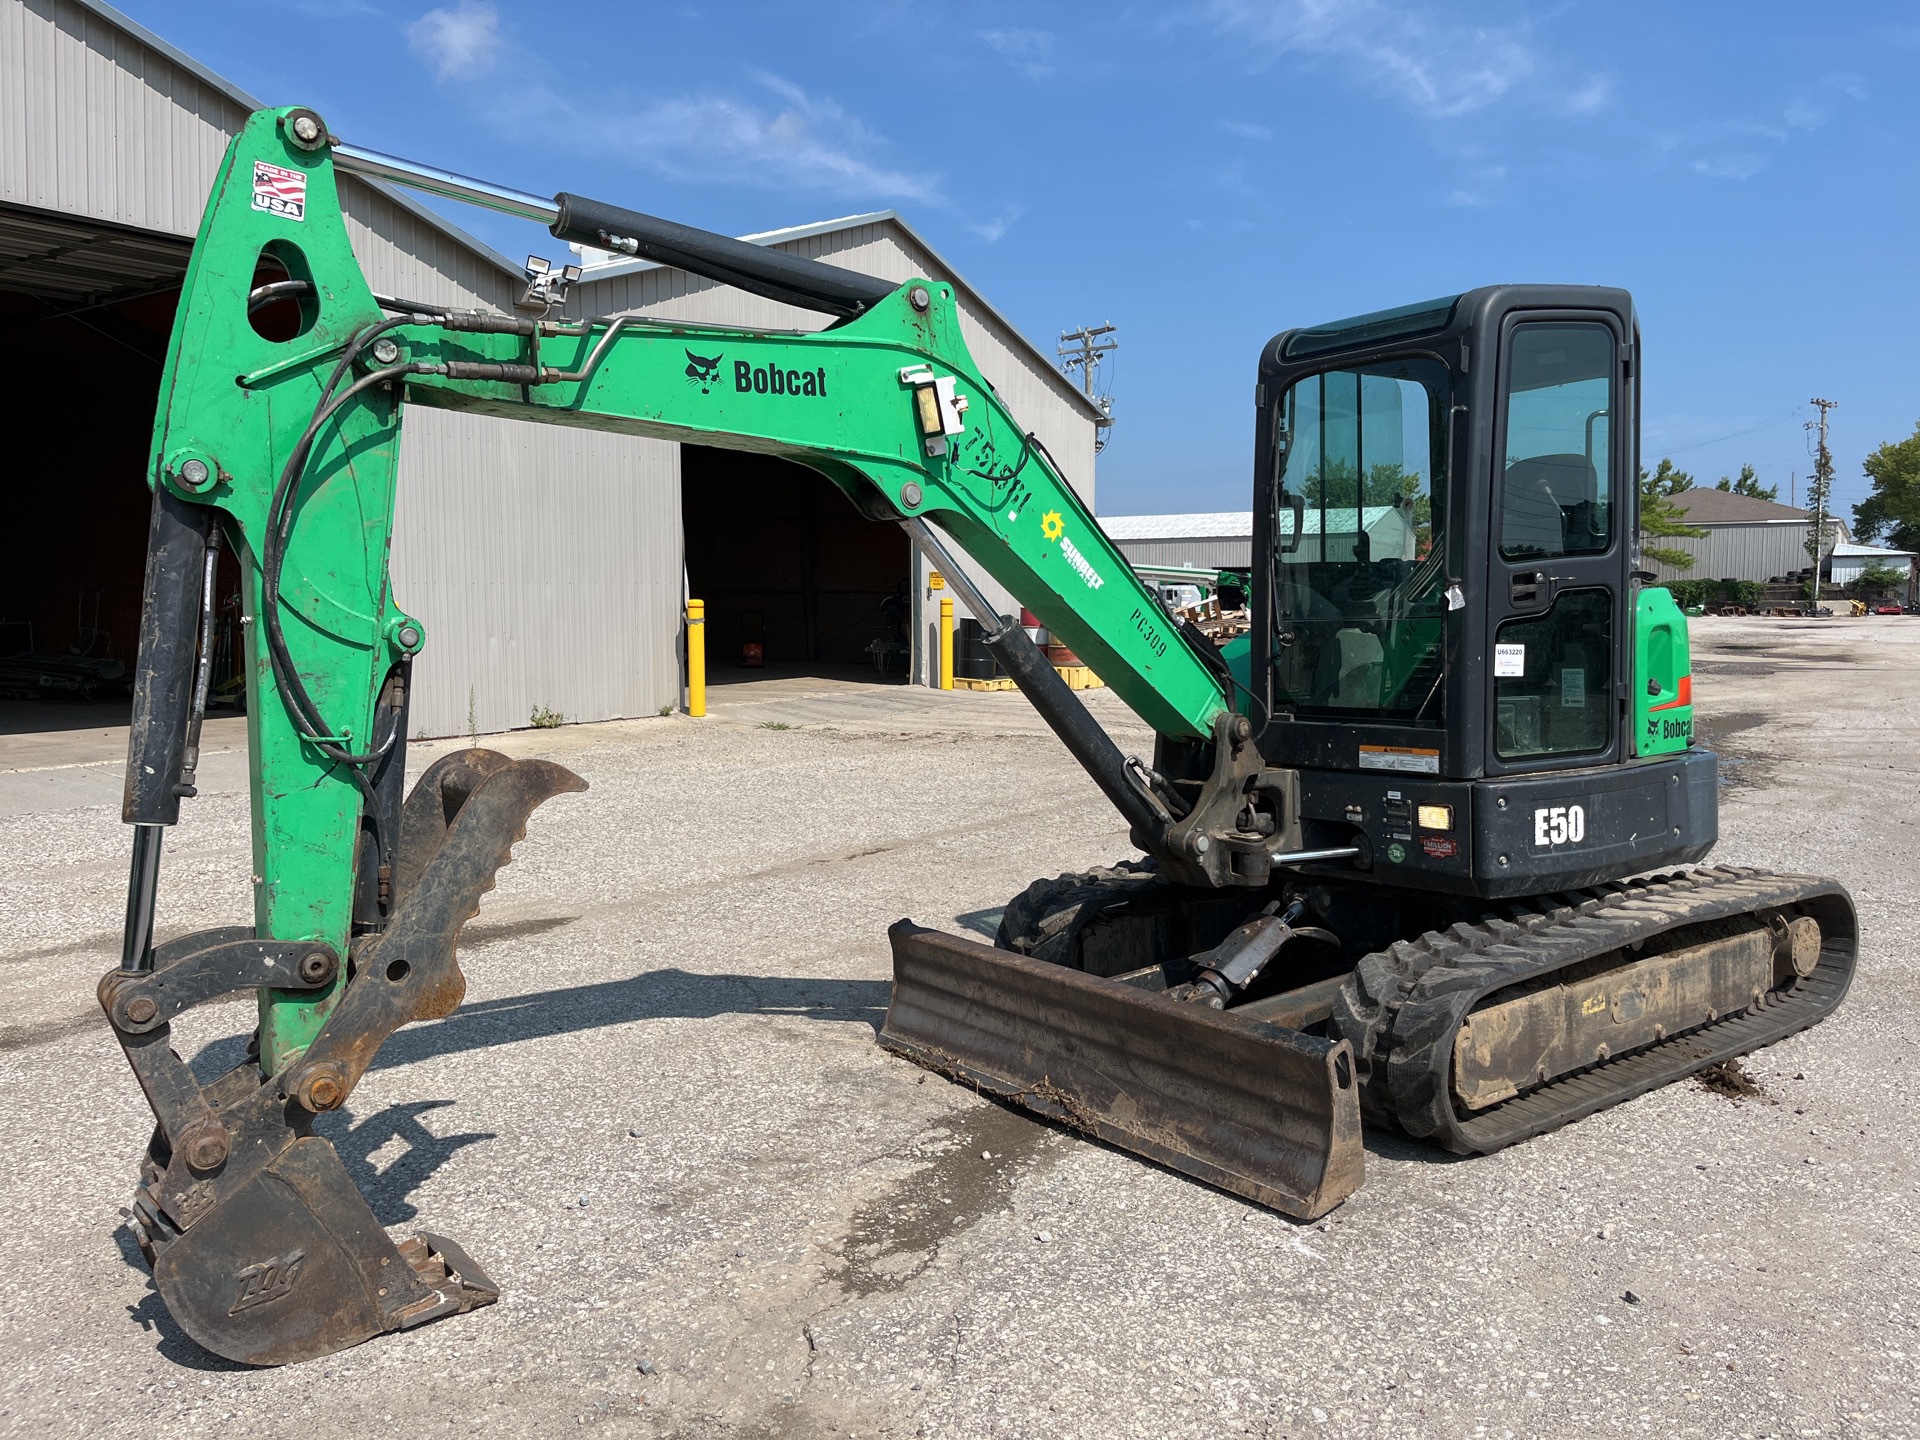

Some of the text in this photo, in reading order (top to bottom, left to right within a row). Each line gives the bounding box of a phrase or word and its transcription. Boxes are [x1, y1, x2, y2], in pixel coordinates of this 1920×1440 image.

[258, 164, 279, 175] MADE
[289, 172, 303, 180] THE
[255, 194, 300, 216] USA
[734, 360, 827, 397] Bobcat
[1059, 536, 1105, 590] SUNBELT
[1129, 608, 1168, 658] PC309
[1534, 804, 1585, 846] E50
[1427, 841, 1452, 850] MILLION
